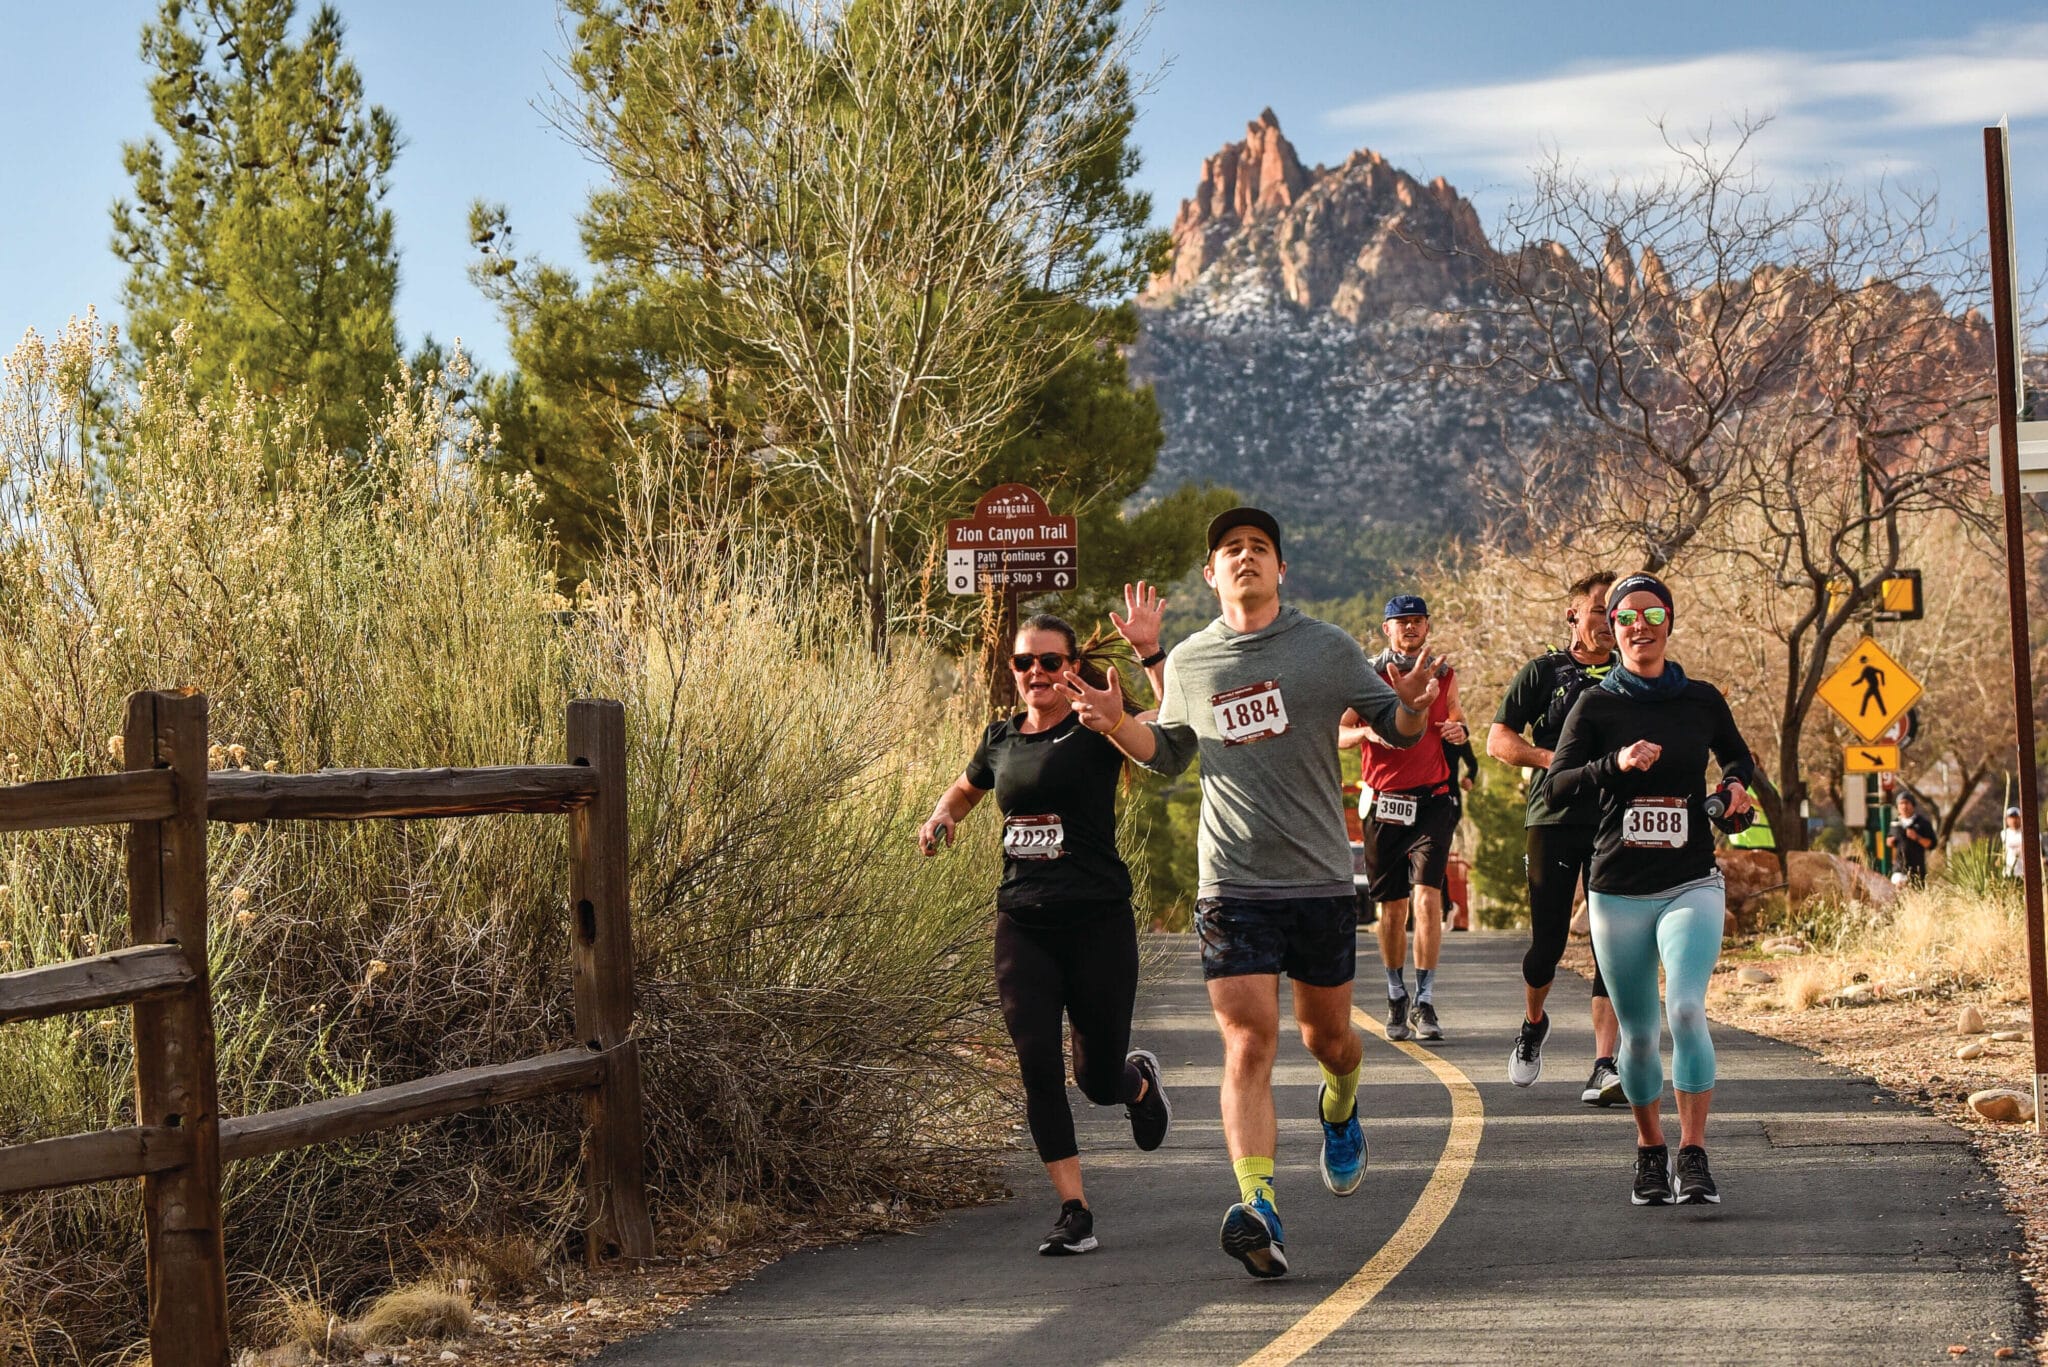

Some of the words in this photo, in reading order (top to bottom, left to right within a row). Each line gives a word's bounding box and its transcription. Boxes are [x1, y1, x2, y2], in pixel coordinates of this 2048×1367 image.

[987, 504, 1035, 515] SPRINGDALE
[956, 526, 983, 542] Zion
[988, 526, 1035, 545] Canyon
[1039, 523, 1068, 540] Trail
[977, 551, 998, 563] Path
[1001, 550, 1046, 562] Continues
[1013, 572, 1033, 585] Stop
[1036, 571, 1042, 583] 9
[1222, 695, 1280, 731] 1884
[1380, 800, 1413, 817] 3906
[1629, 810, 1682, 833] 3688
